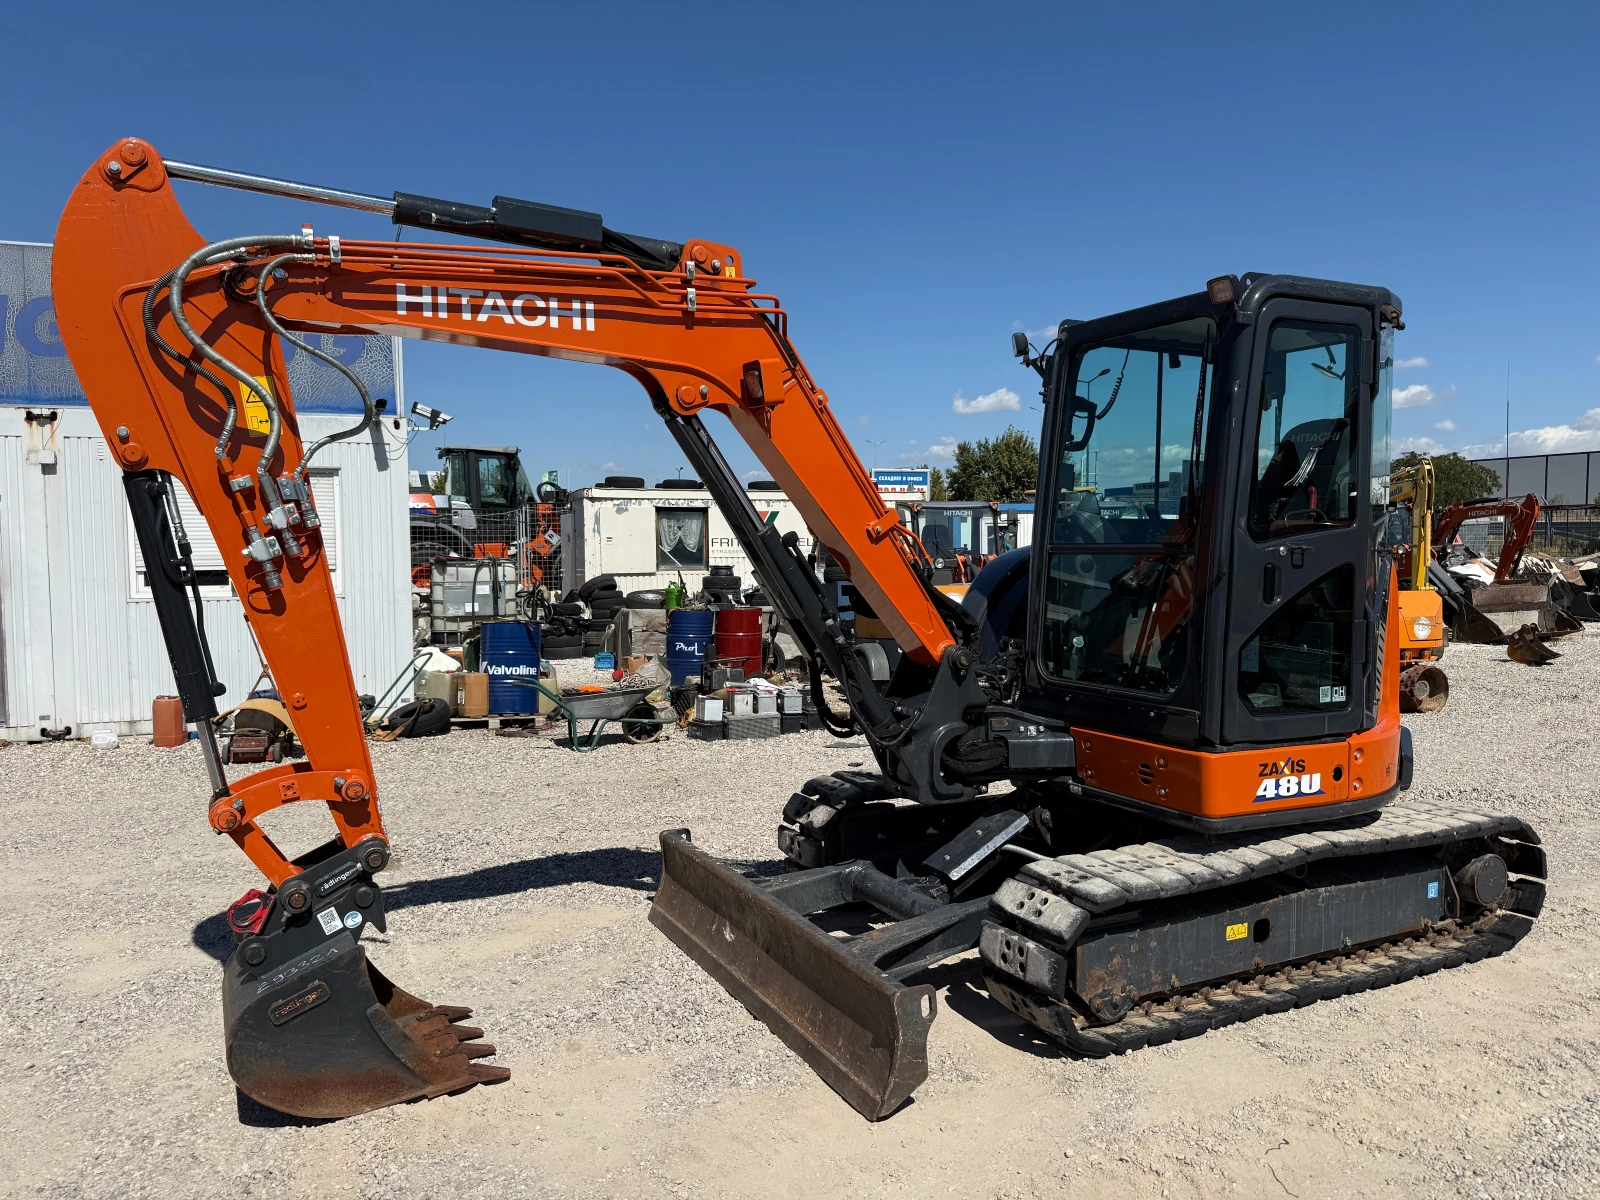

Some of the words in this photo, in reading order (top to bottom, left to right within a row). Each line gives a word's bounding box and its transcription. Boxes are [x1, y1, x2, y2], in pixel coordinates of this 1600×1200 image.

[396, 283, 595, 331] HITACHI
[1292, 431, 1340, 442] HITACHI
[1468, 509, 1497, 517] HITACHI
[486, 664, 538, 676] Valvoline
[1258, 757, 1307, 778] ZAXIS
[1255, 773, 1321, 799] 48U
